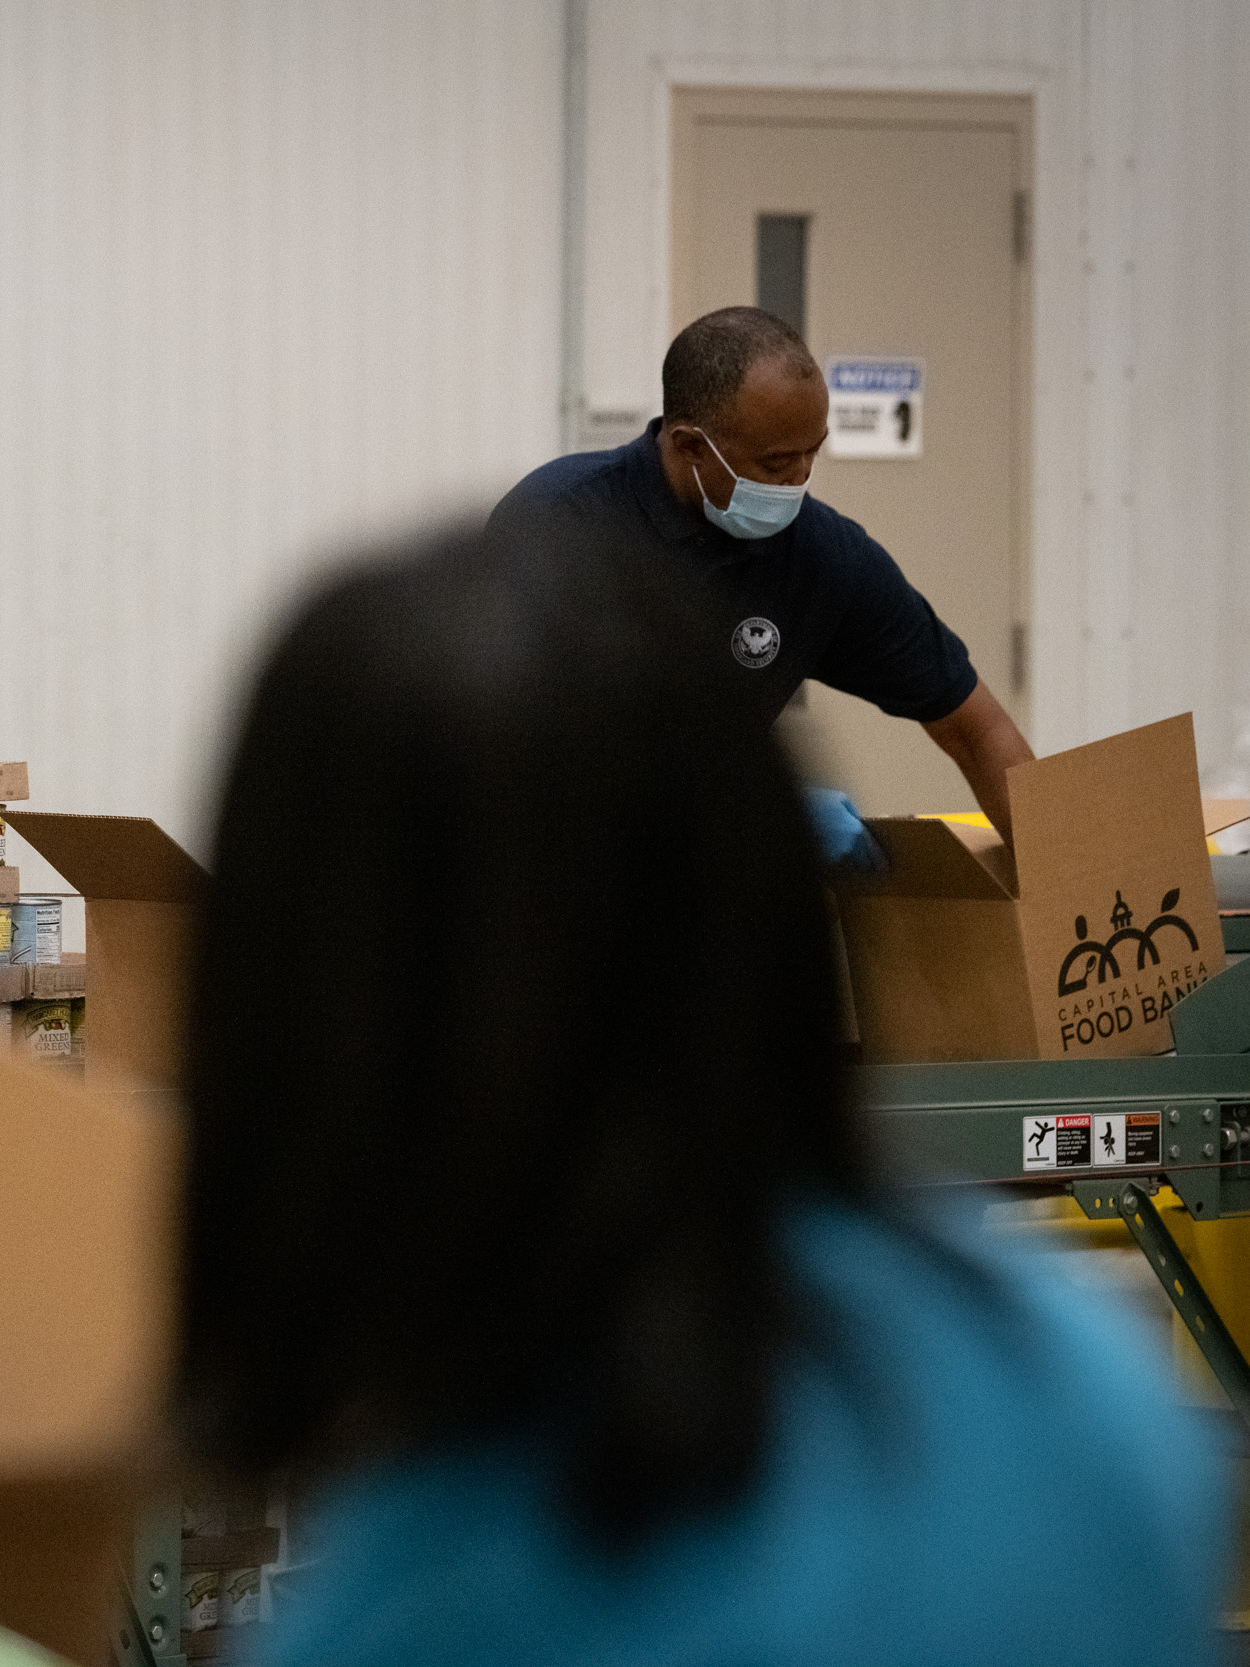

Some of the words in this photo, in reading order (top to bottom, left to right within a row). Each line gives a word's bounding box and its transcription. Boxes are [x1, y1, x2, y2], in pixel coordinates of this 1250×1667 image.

[1058, 982, 1144, 1022] CAPITAL
[1157, 960, 1208, 990] AREA
[38, 1032, 70, 1042] MIXED
[1061, 1005, 1133, 1052] FOOD
[1065, 1117, 1090, 1127] DANGER
